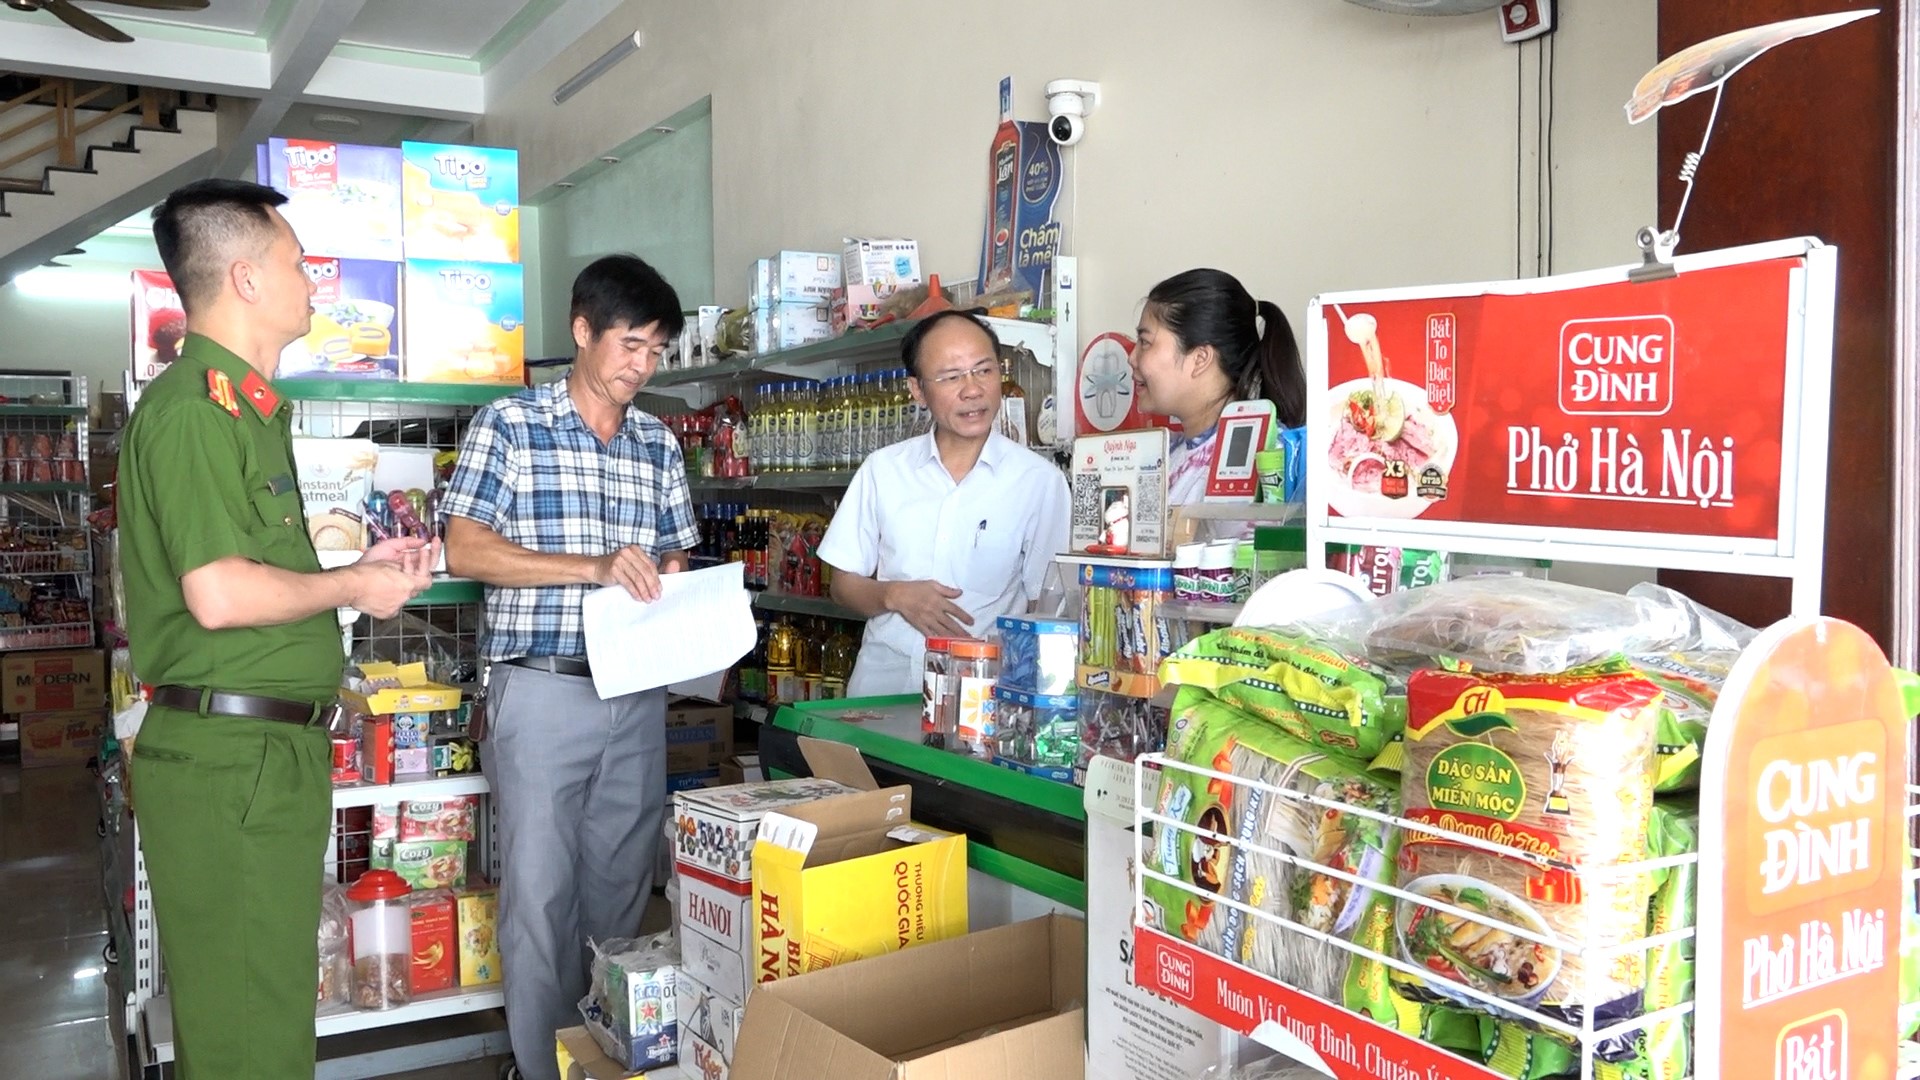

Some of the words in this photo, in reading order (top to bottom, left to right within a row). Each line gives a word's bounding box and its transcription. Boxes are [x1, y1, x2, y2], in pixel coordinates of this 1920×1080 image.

[283, 145, 336, 171] Tipo
[434, 155, 486, 180] Tipo
[303, 260, 339, 283] ipo
[439, 268, 491, 293] Tipo
[1430, 317, 1451, 339] Bát
[1433, 339, 1448, 360] To
[1568, 332, 1663, 366] CUNG
[1428, 362, 1452, 384] Đặc
[1570, 367, 1658, 402] ĐÌNH
[1428, 383, 1452, 406] Biệt
[1384, 459, 1405, 478] X3
[1507, 426, 1580, 492] Phở
[1590, 427, 1649, 496] Hà
[1660, 428, 1734, 508] Nội
[301, 490, 348, 502] atmeal
[1437, 757, 1471, 781] ĐẶC
[1475, 758, 1512, 785] SẢN
[1250, 778, 1268, 814] KIÊ
[1431, 784, 1474, 807] MIẾN
[1475, 791, 1516, 816] MỘC
[1757, 751, 1877, 824] CUNG
[410, 802, 440, 813] Cozy
[400, 846, 430, 859] Cozy
[1760, 817, 1871, 895] ĐÌNH
[1235, 853, 1249, 890] SẠCH
[893, 861, 910, 917] QUỐC
[688, 891, 732, 938] HANOI
[761, 890, 785, 940] HÀ
[1230, 888, 1243, 929] DOG
[898, 920, 910, 950] GIA
[787, 938, 801, 978] BIA
[1159, 950, 1191, 977] CUNG
[1743, 933, 1795, 1002] Phở
[1799, 919, 1837, 985] Hà
[1840, 907, 1885, 975] Nội
[1161, 970, 1190, 994] ĐÌNH
